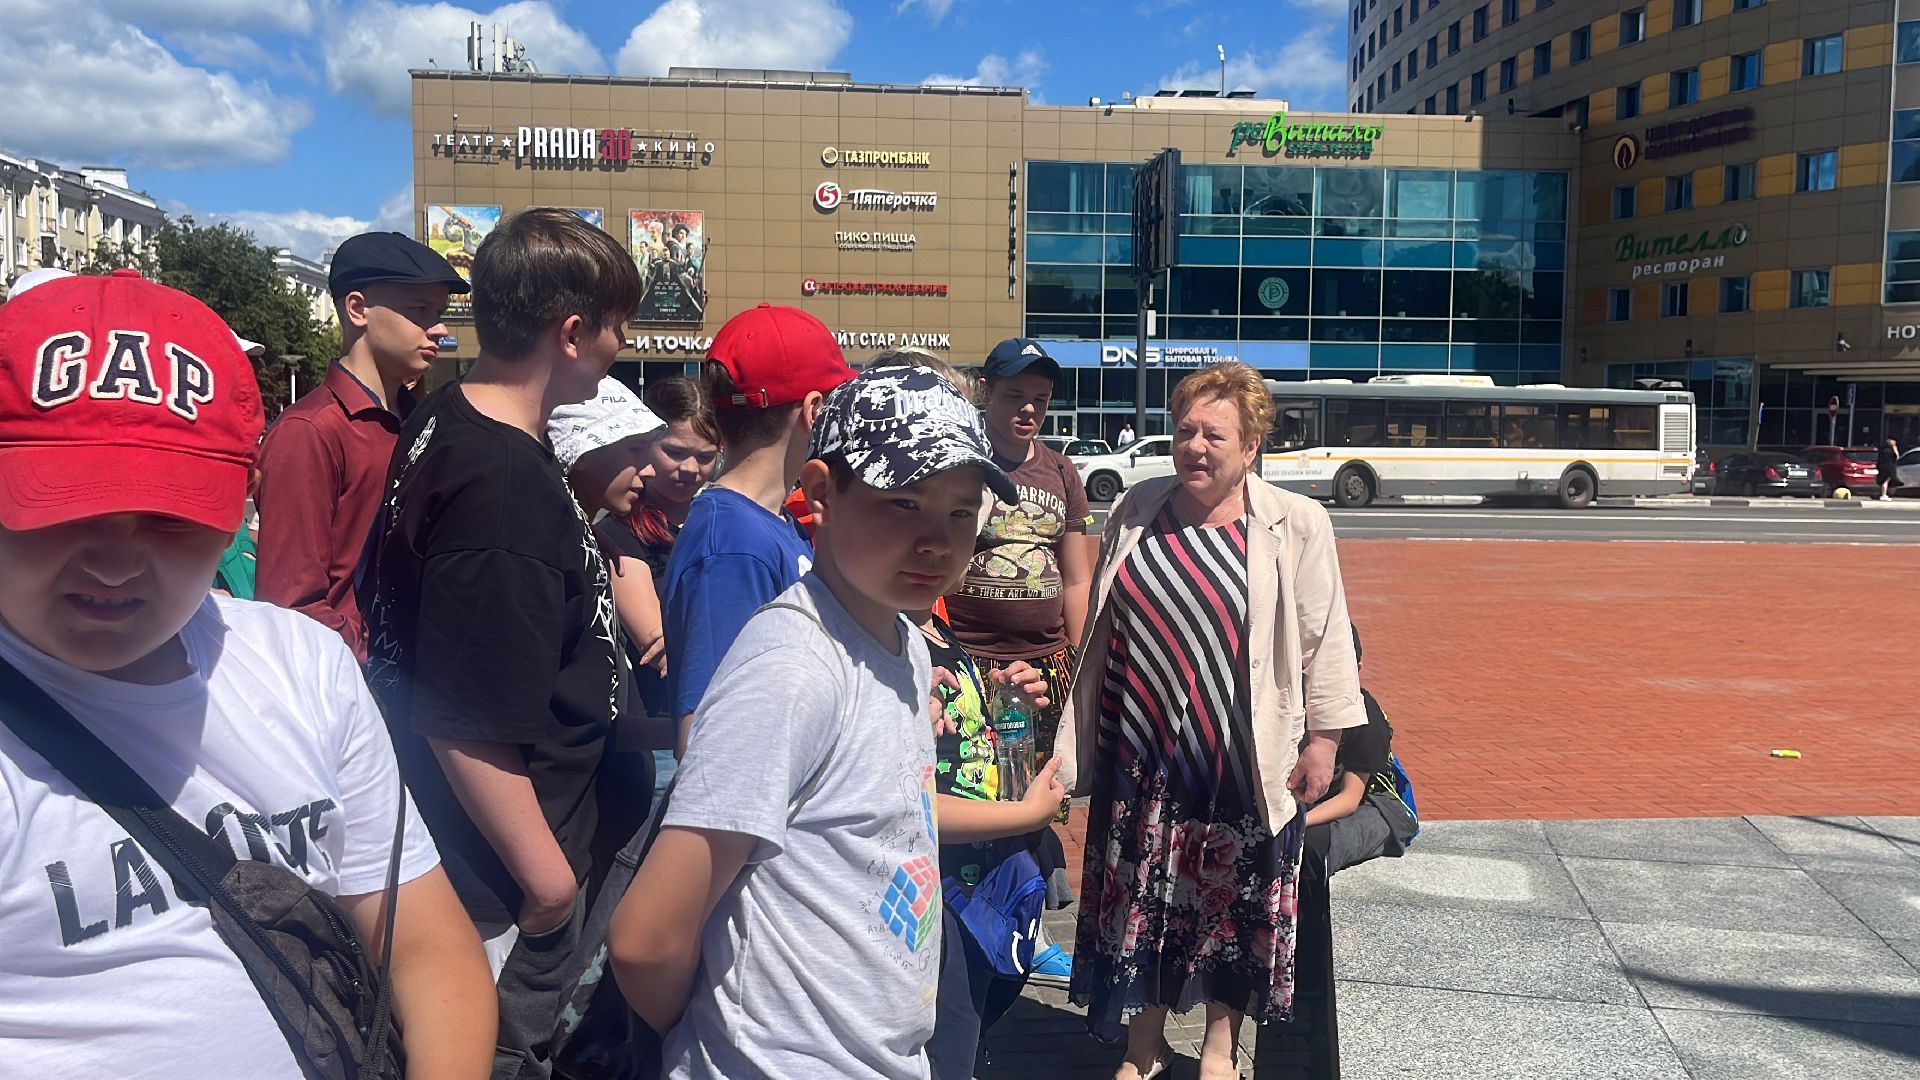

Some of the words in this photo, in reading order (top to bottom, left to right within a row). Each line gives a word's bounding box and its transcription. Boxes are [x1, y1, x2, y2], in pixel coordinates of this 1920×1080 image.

[433, 134, 495, 147] ТЕАТР
[518, 126, 596, 159] PRADA
[600, 128, 631, 160] 3D
[654, 140, 716, 154] КИНО
[844, 150, 931, 165] ГАЗПРОМБАНК
[835, 231, 870, 243] ПИКО
[874, 232, 917, 244] ПИЦЦА
[1632, 255, 1726, 280] ресторан
[860, 332, 896, 346] СТАР
[1887, 325, 1920, 339] HO
[653, 335, 714, 351] ТОЧКА
[1102, 345, 1161, 363] DNS
[32, 329, 214, 421] GAP
[601, 396, 627, 404] FILA
[979, 587, 1004, 598] THERE
[1008, 590, 1024, 598] ARE
